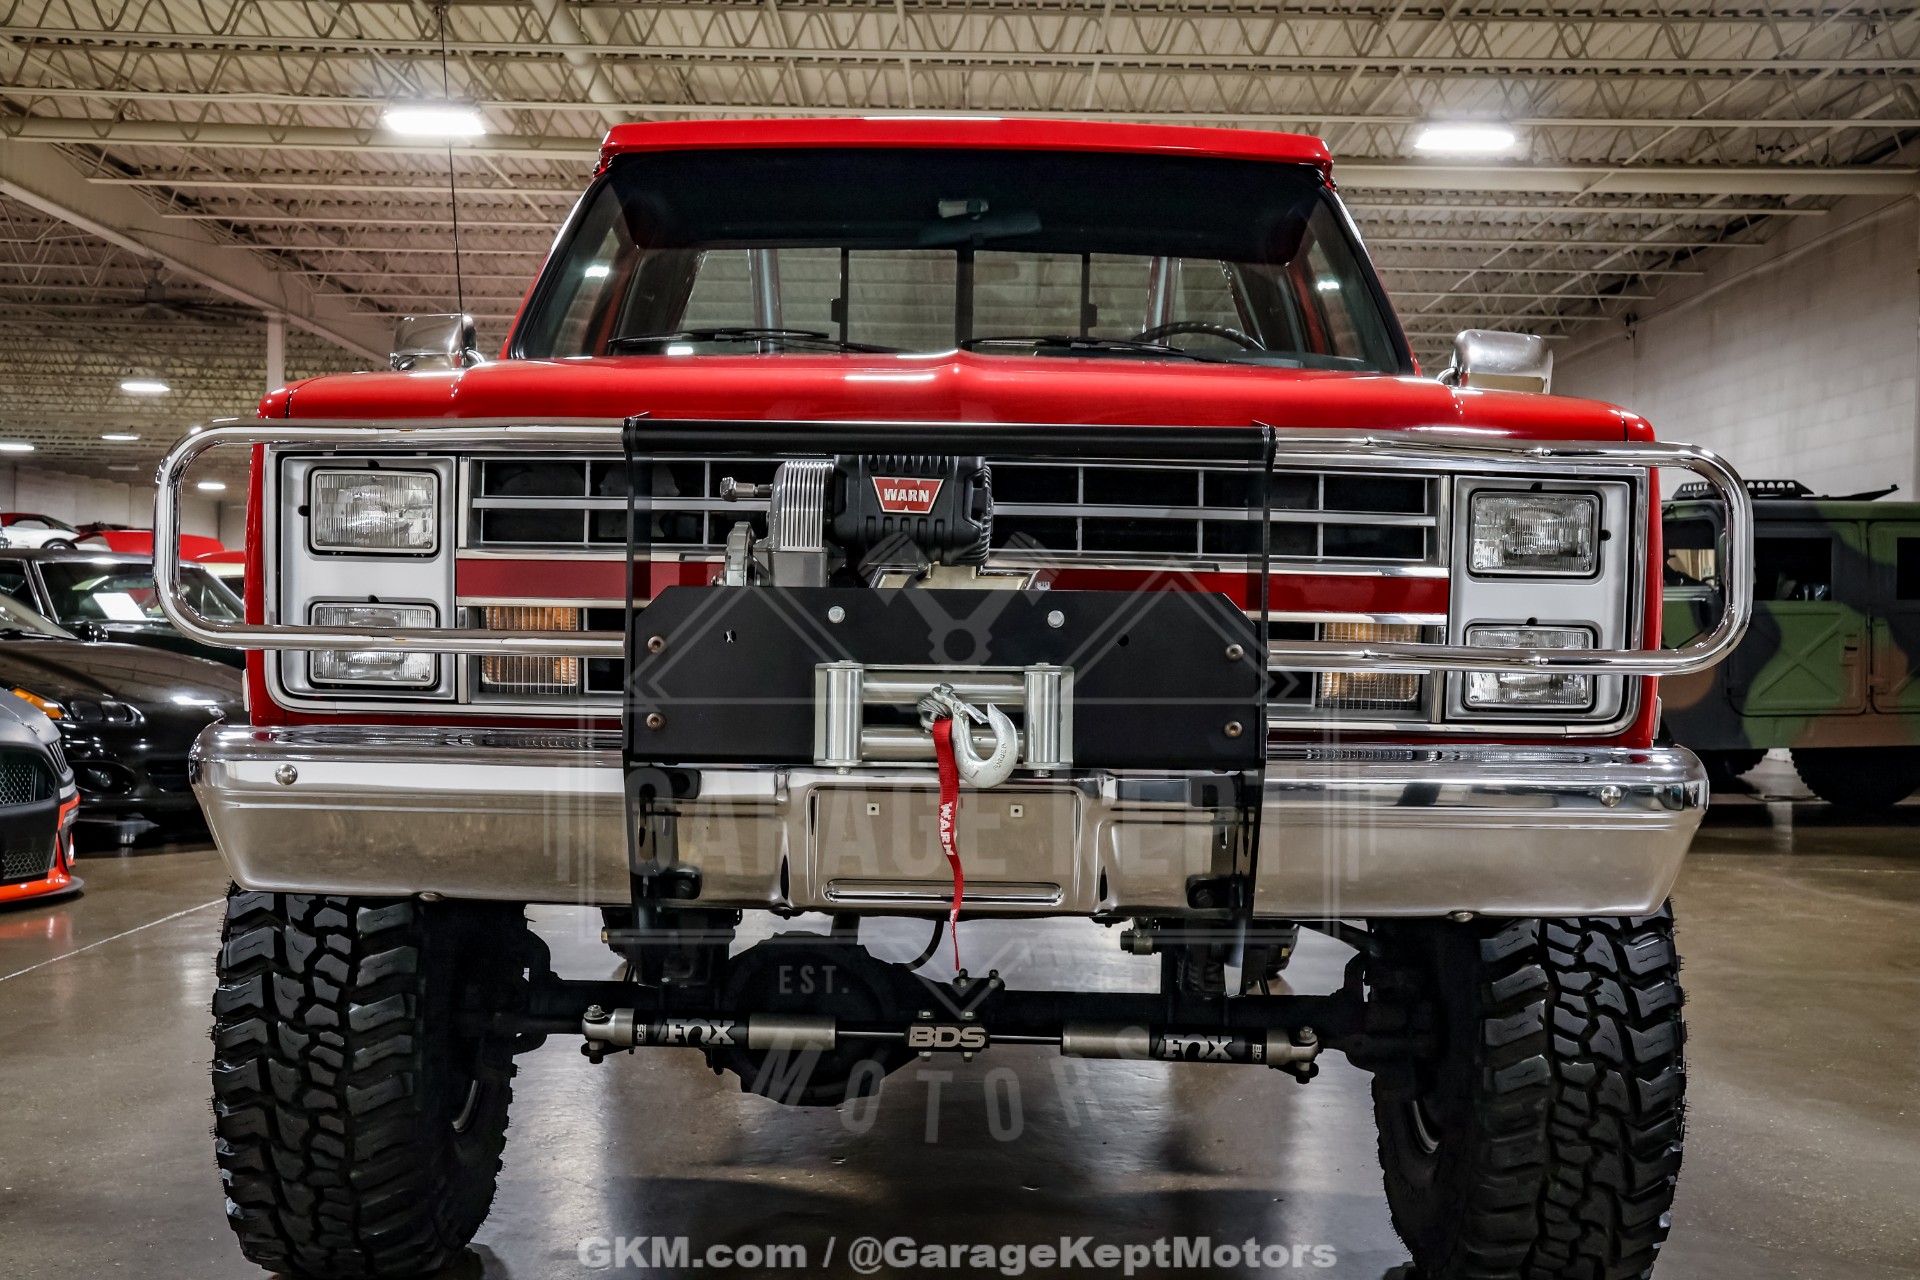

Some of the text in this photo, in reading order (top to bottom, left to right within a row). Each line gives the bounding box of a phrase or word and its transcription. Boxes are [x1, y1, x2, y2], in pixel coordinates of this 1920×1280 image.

[883, 488, 930, 503] WARN
[939, 801, 955, 856] WARN
[666, 1018, 735, 1046] FOX
[908, 1026, 986, 1048] BDS
[1164, 1033, 1233, 1060] FOX
[1254, 1043, 1262, 1062] BD
